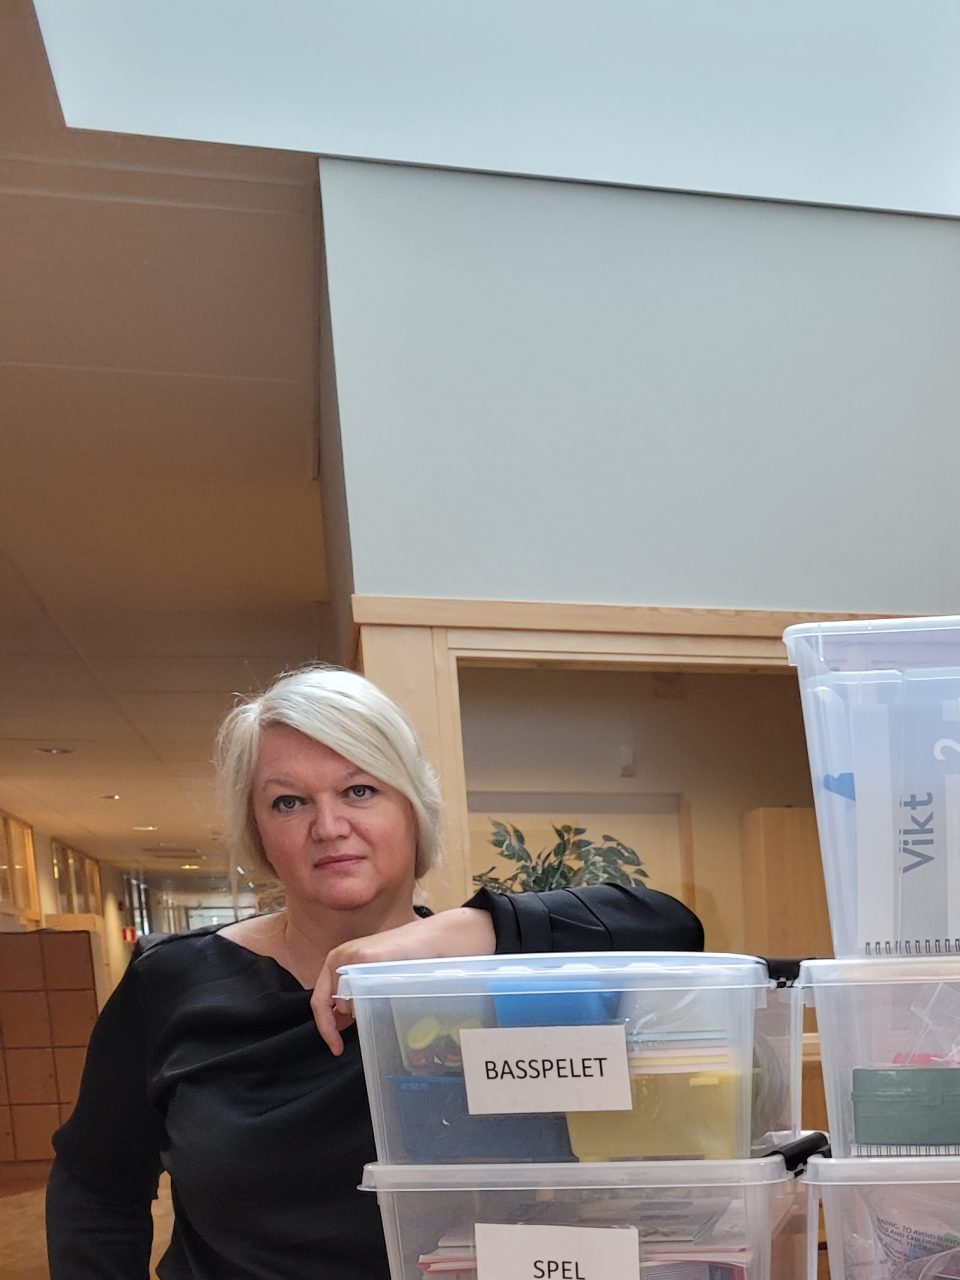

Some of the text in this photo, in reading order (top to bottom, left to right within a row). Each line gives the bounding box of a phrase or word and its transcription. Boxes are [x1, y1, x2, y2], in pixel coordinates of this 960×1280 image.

[900, 791, 934, 873] Vikt
[484, 1057, 608, 1080] BASSPELET
[533, 1259, 586, 1280] SPEL
